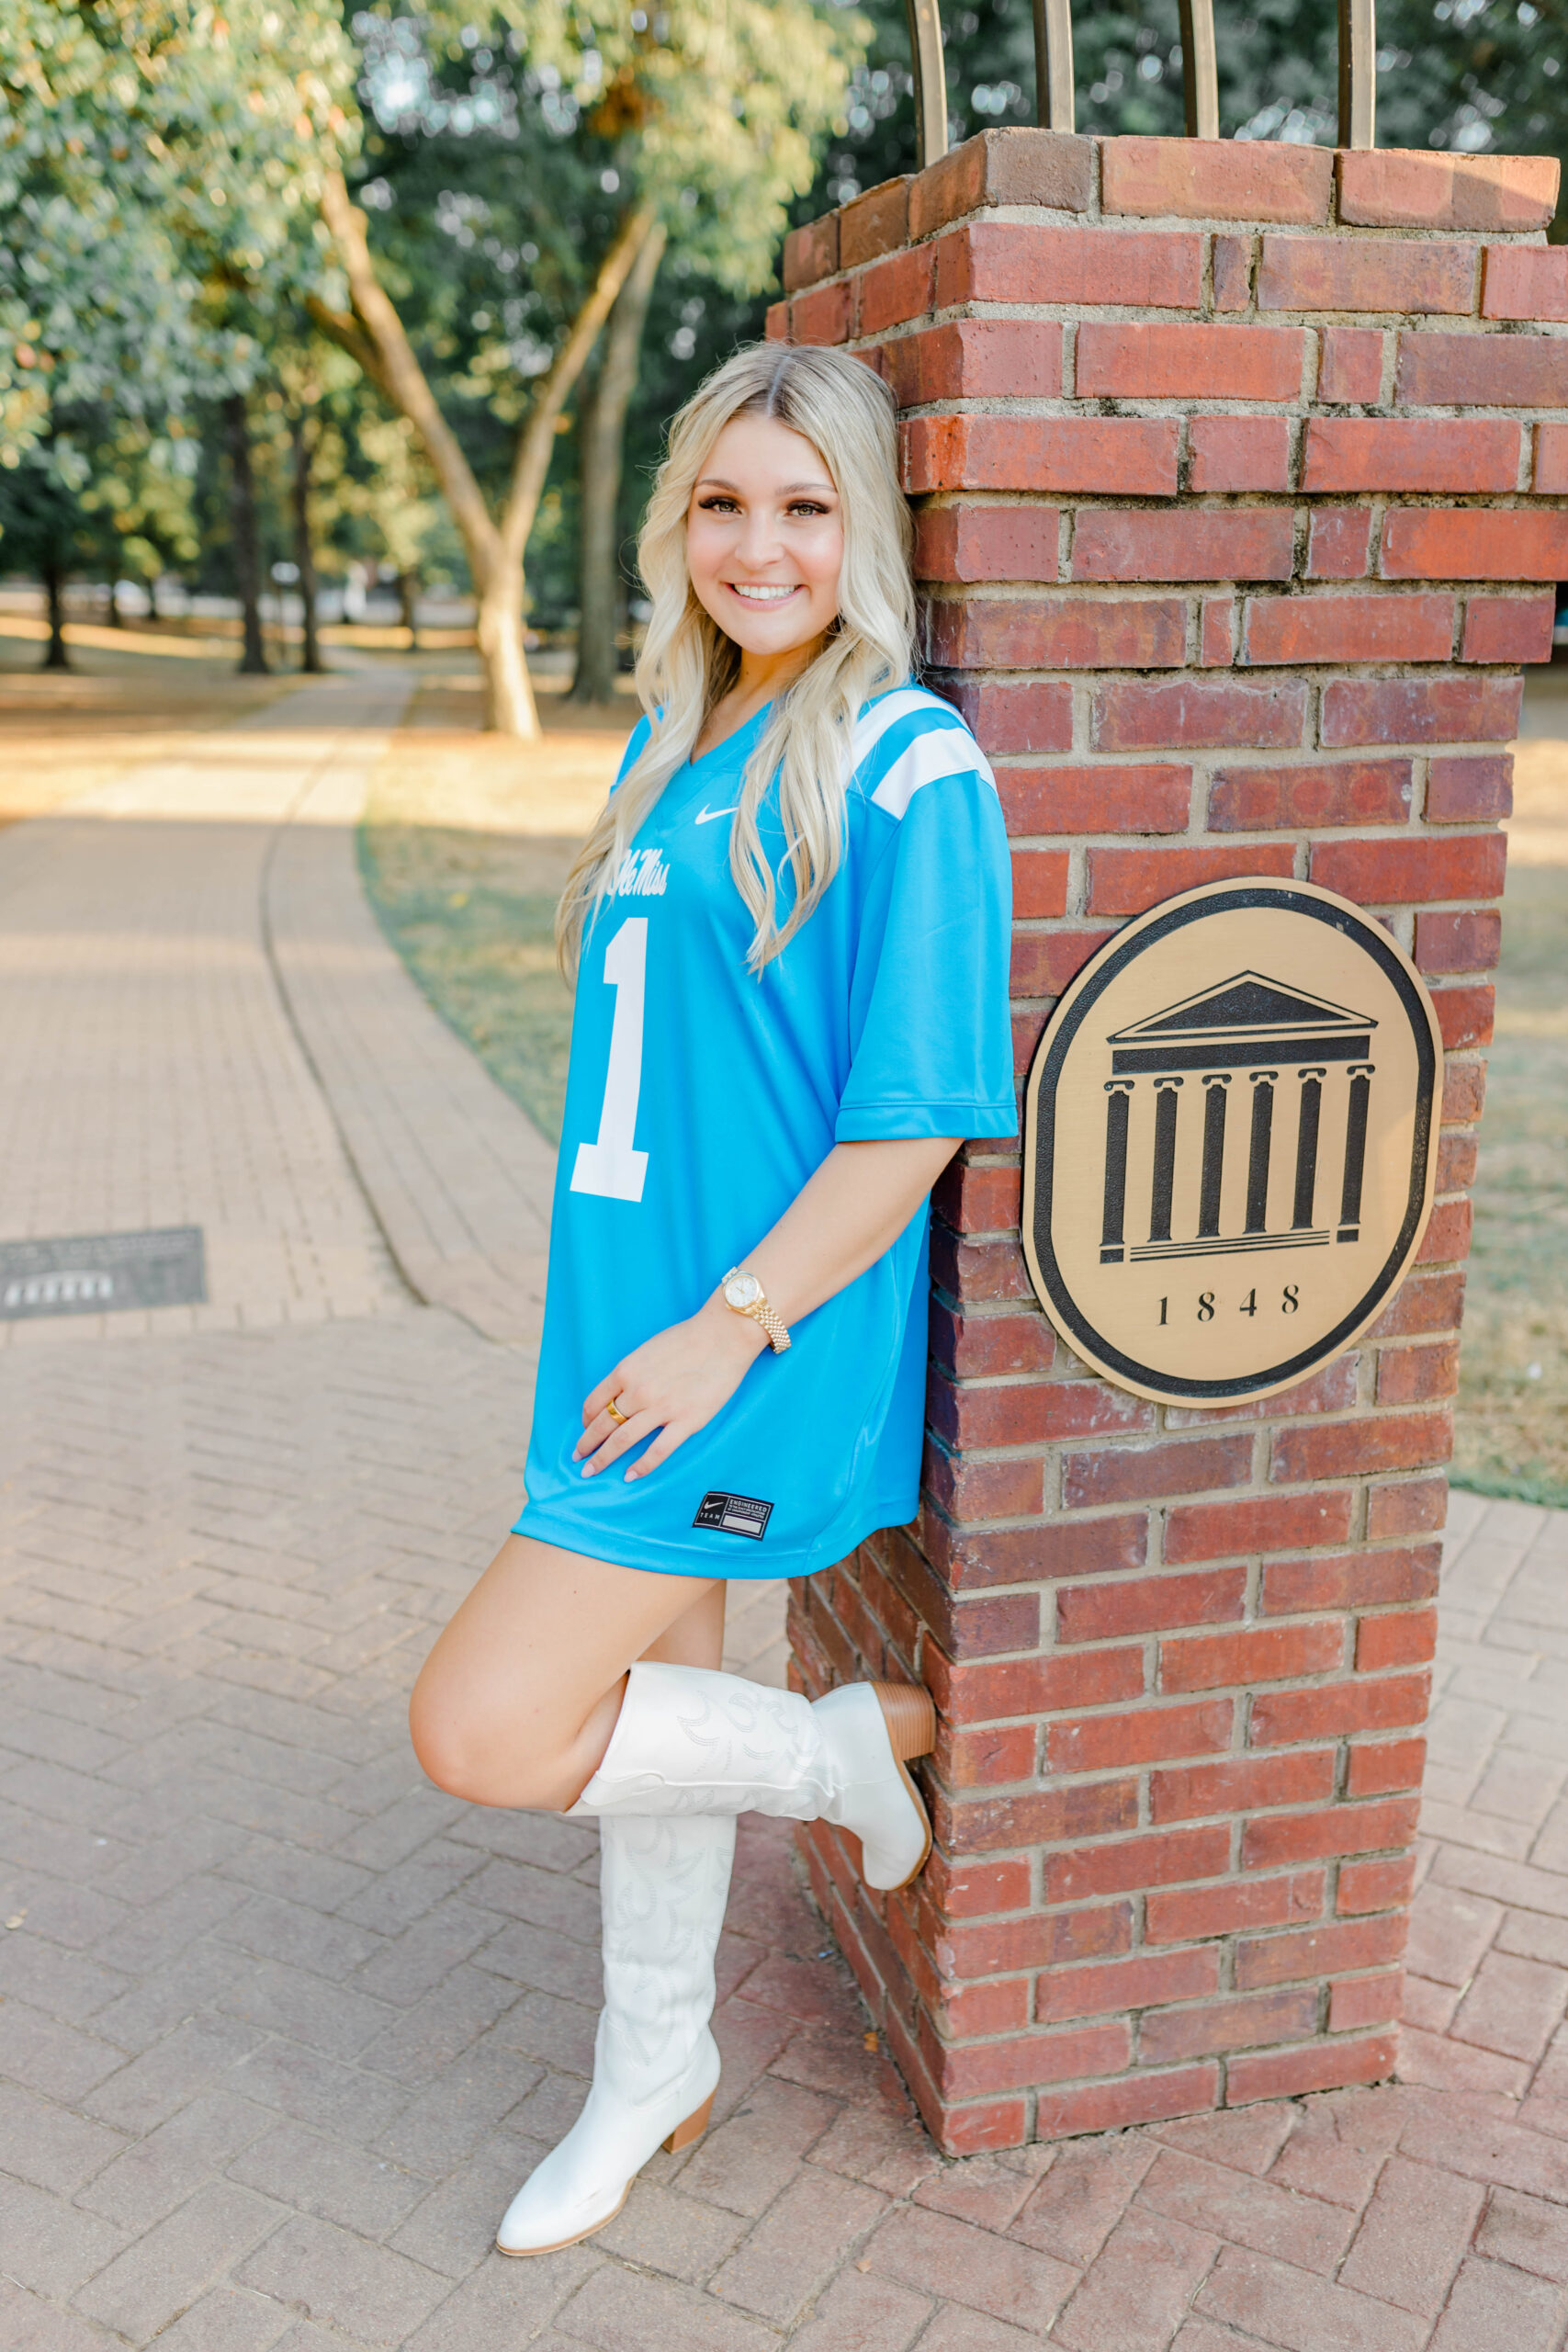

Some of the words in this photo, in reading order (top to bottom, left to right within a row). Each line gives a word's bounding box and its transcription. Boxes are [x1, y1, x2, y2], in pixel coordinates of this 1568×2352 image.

[633, 848, 671, 897] Miss
[570, 917, 649, 1203] 1
[1157, 1284, 1300, 1326] 1848
[729, 1498, 768, 1513] ENGINEERED
